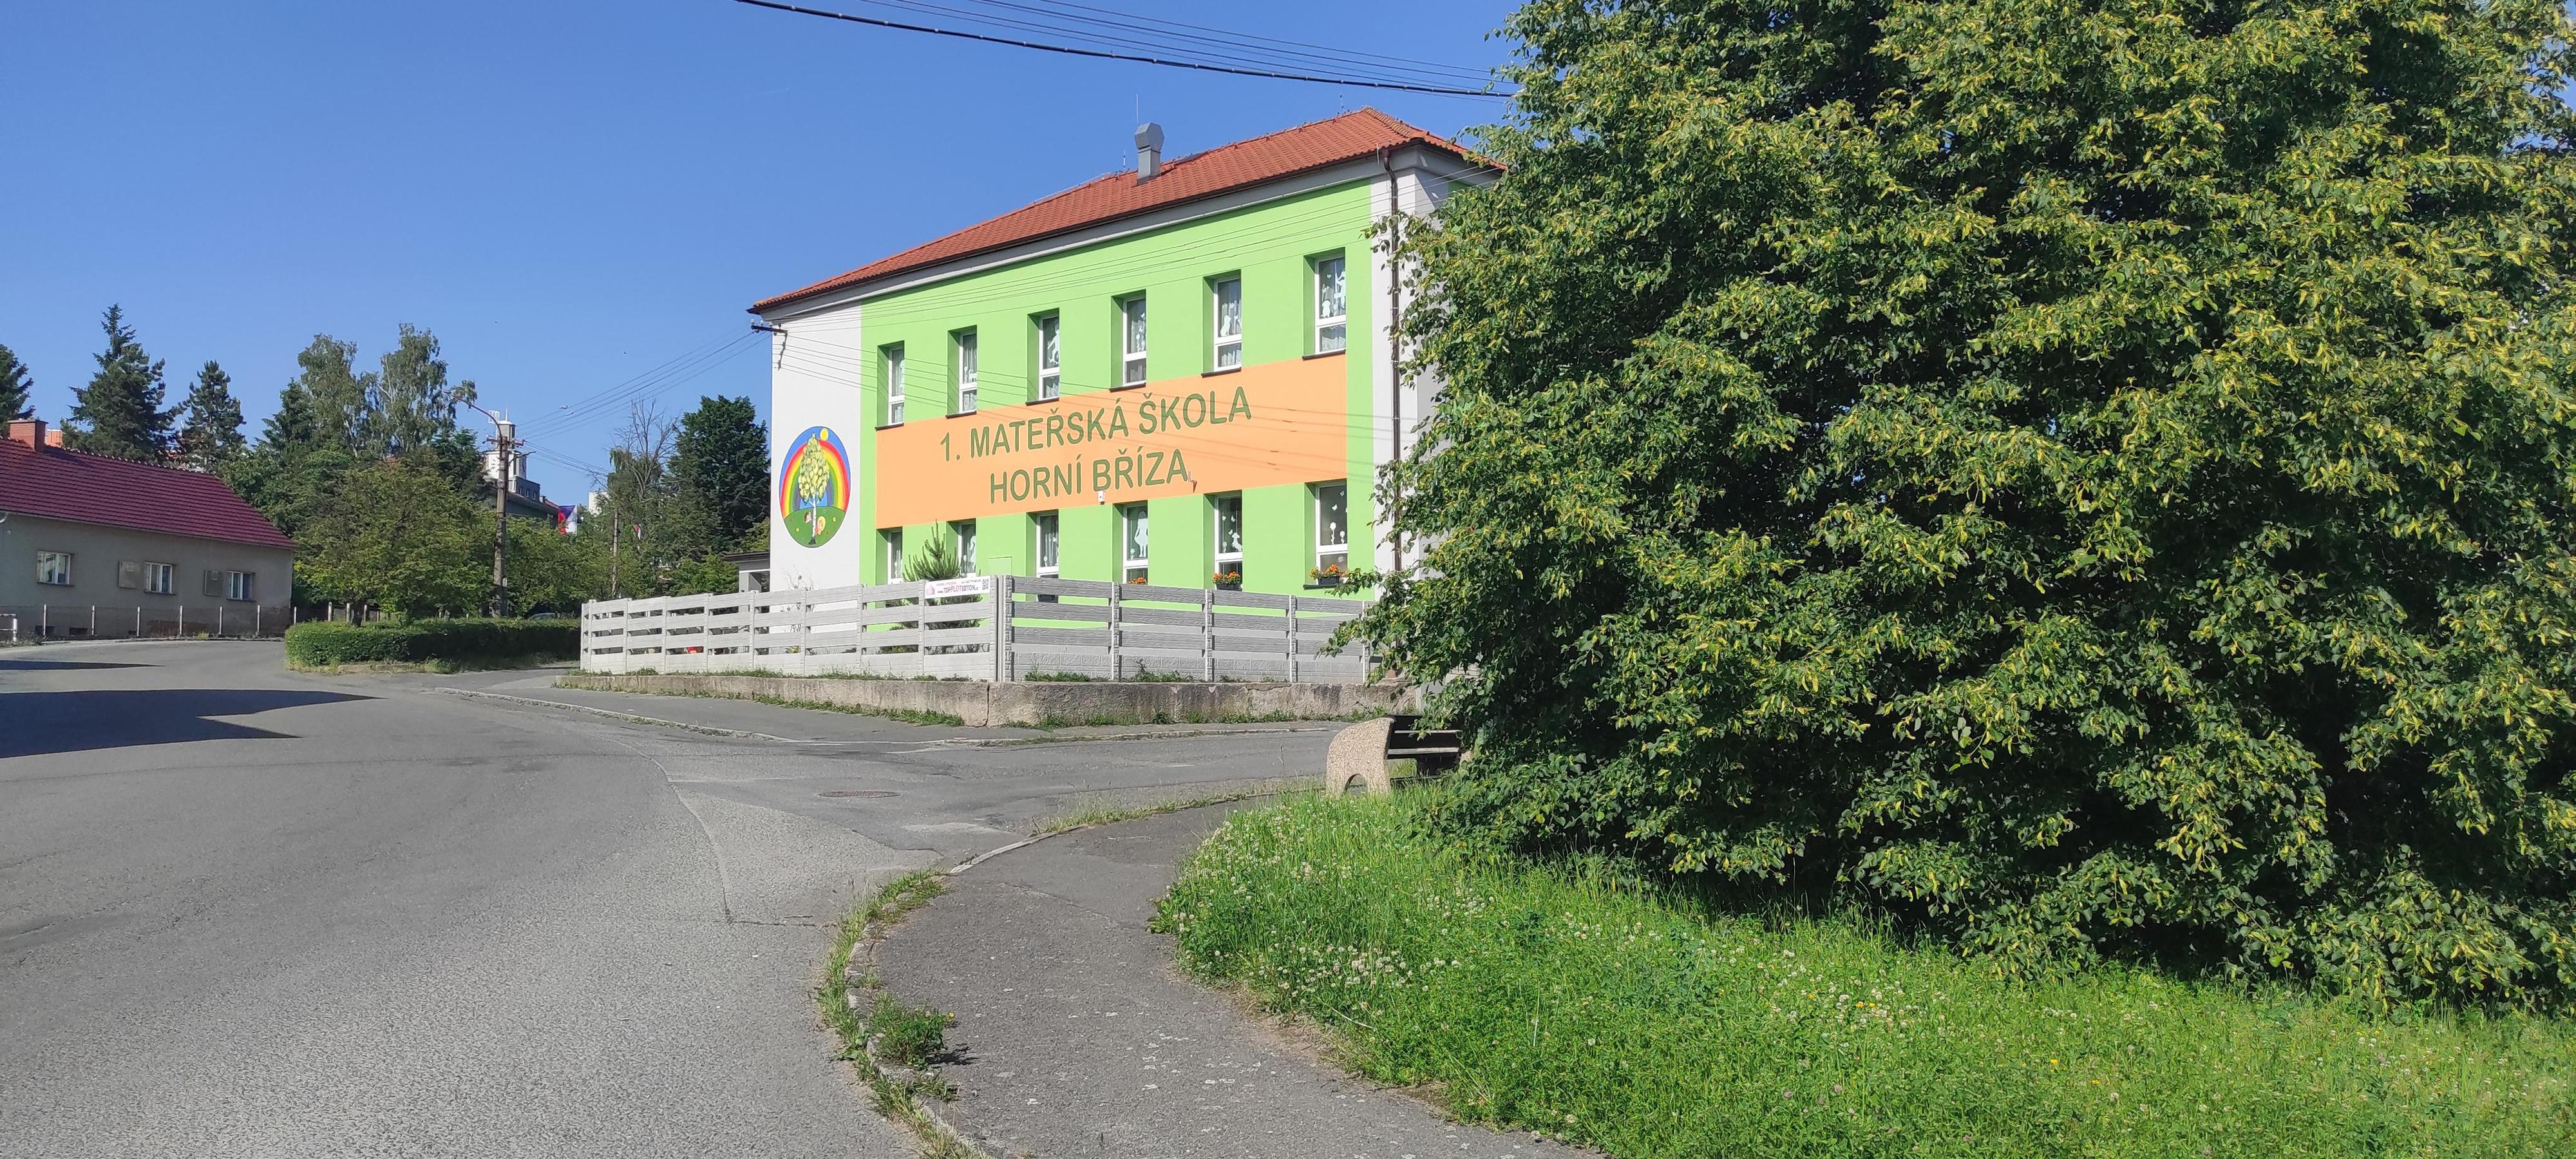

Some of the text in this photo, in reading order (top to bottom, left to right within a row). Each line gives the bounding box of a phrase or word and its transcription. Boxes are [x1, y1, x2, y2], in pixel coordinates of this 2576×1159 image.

[940, 387, 1252, 462] 1. MATEŘSKÁ ŠKOLA
[990, 446, 1189, 504] HORNÍ BŘÍZA
